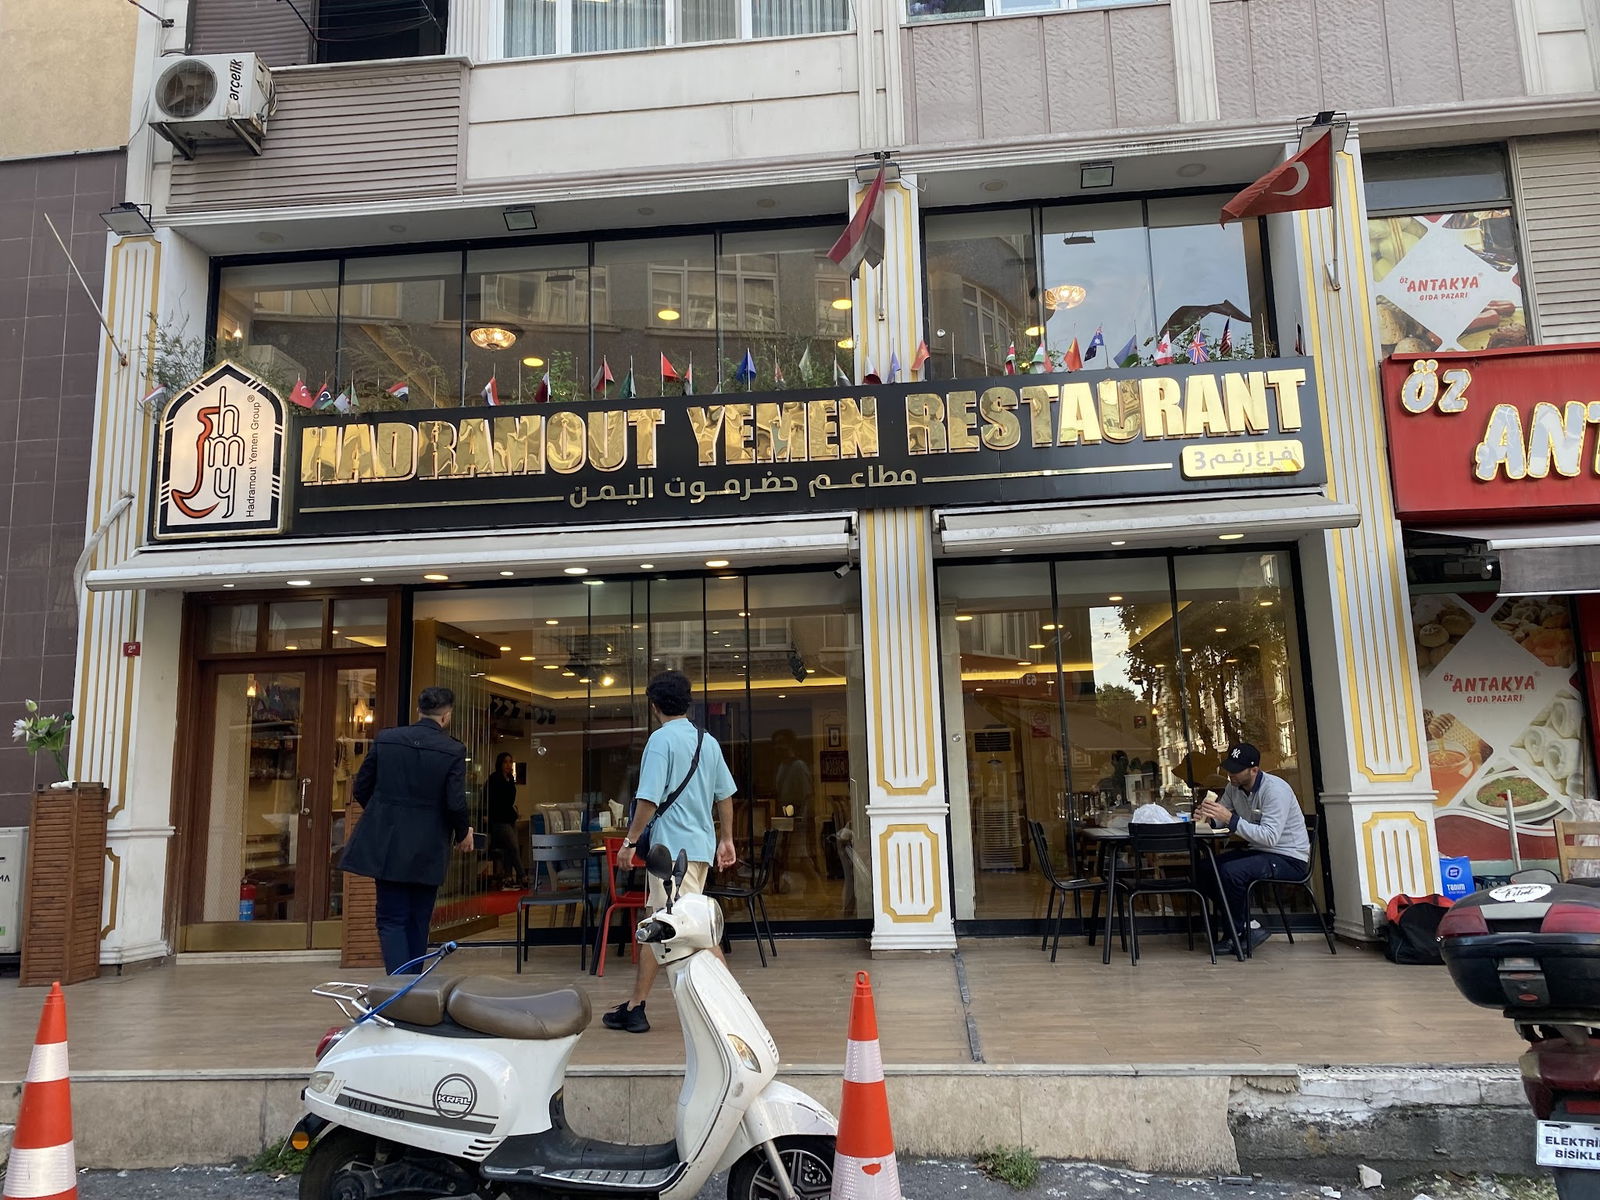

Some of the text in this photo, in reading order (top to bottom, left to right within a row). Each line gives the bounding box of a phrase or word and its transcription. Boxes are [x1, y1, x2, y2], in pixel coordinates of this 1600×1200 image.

[230, 59, 243, 101] arçelik
[1407, 276, 1479, 292] ANTAKYA
[1441, 292, 1468, 300] PAZARI
[1401, 359, 1472, 414] ÖZ
[301, 369, 1306, 487] HADRAMOUT YEMEN RESTAURANT
[246, 401, 262, 518] Hadramout Yemen Group
[1194, 446, 1294, 470] فرع رقم 3
[568, 464, 917, 508] مطاعم حضرموت اليمن
[1443, 672, 1535, 693] ÖZ ANTAKYA
[1466, 694, 1523, 704] GIDA PAZARI
[437, 1093, 472, 1106] KRAL
[1545, 1136, 1600, 1148] ELEKTRİ
